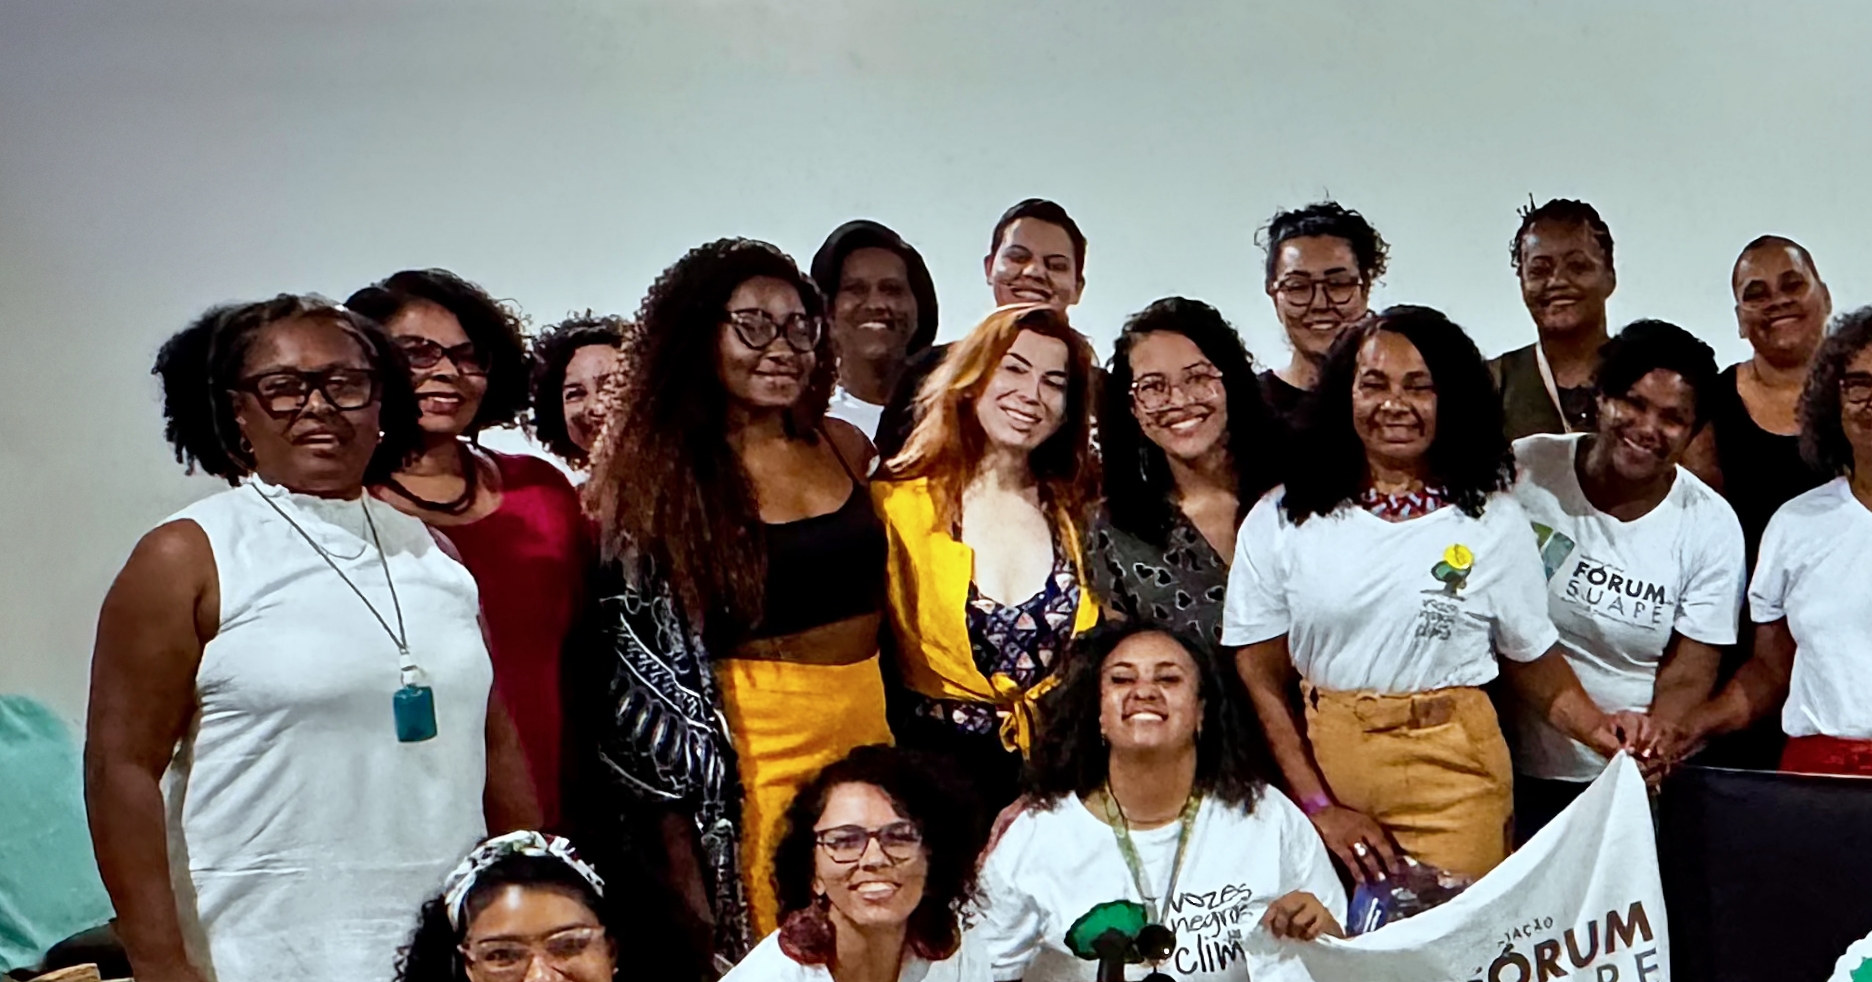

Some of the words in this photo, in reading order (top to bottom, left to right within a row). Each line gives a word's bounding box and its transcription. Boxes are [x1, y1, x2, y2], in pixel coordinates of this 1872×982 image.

[1566, 579, 1664, 625] SUAPE
[1572, 561, 1666, 605] FÓRUM
[1175, 933, 1246, 976] clim
